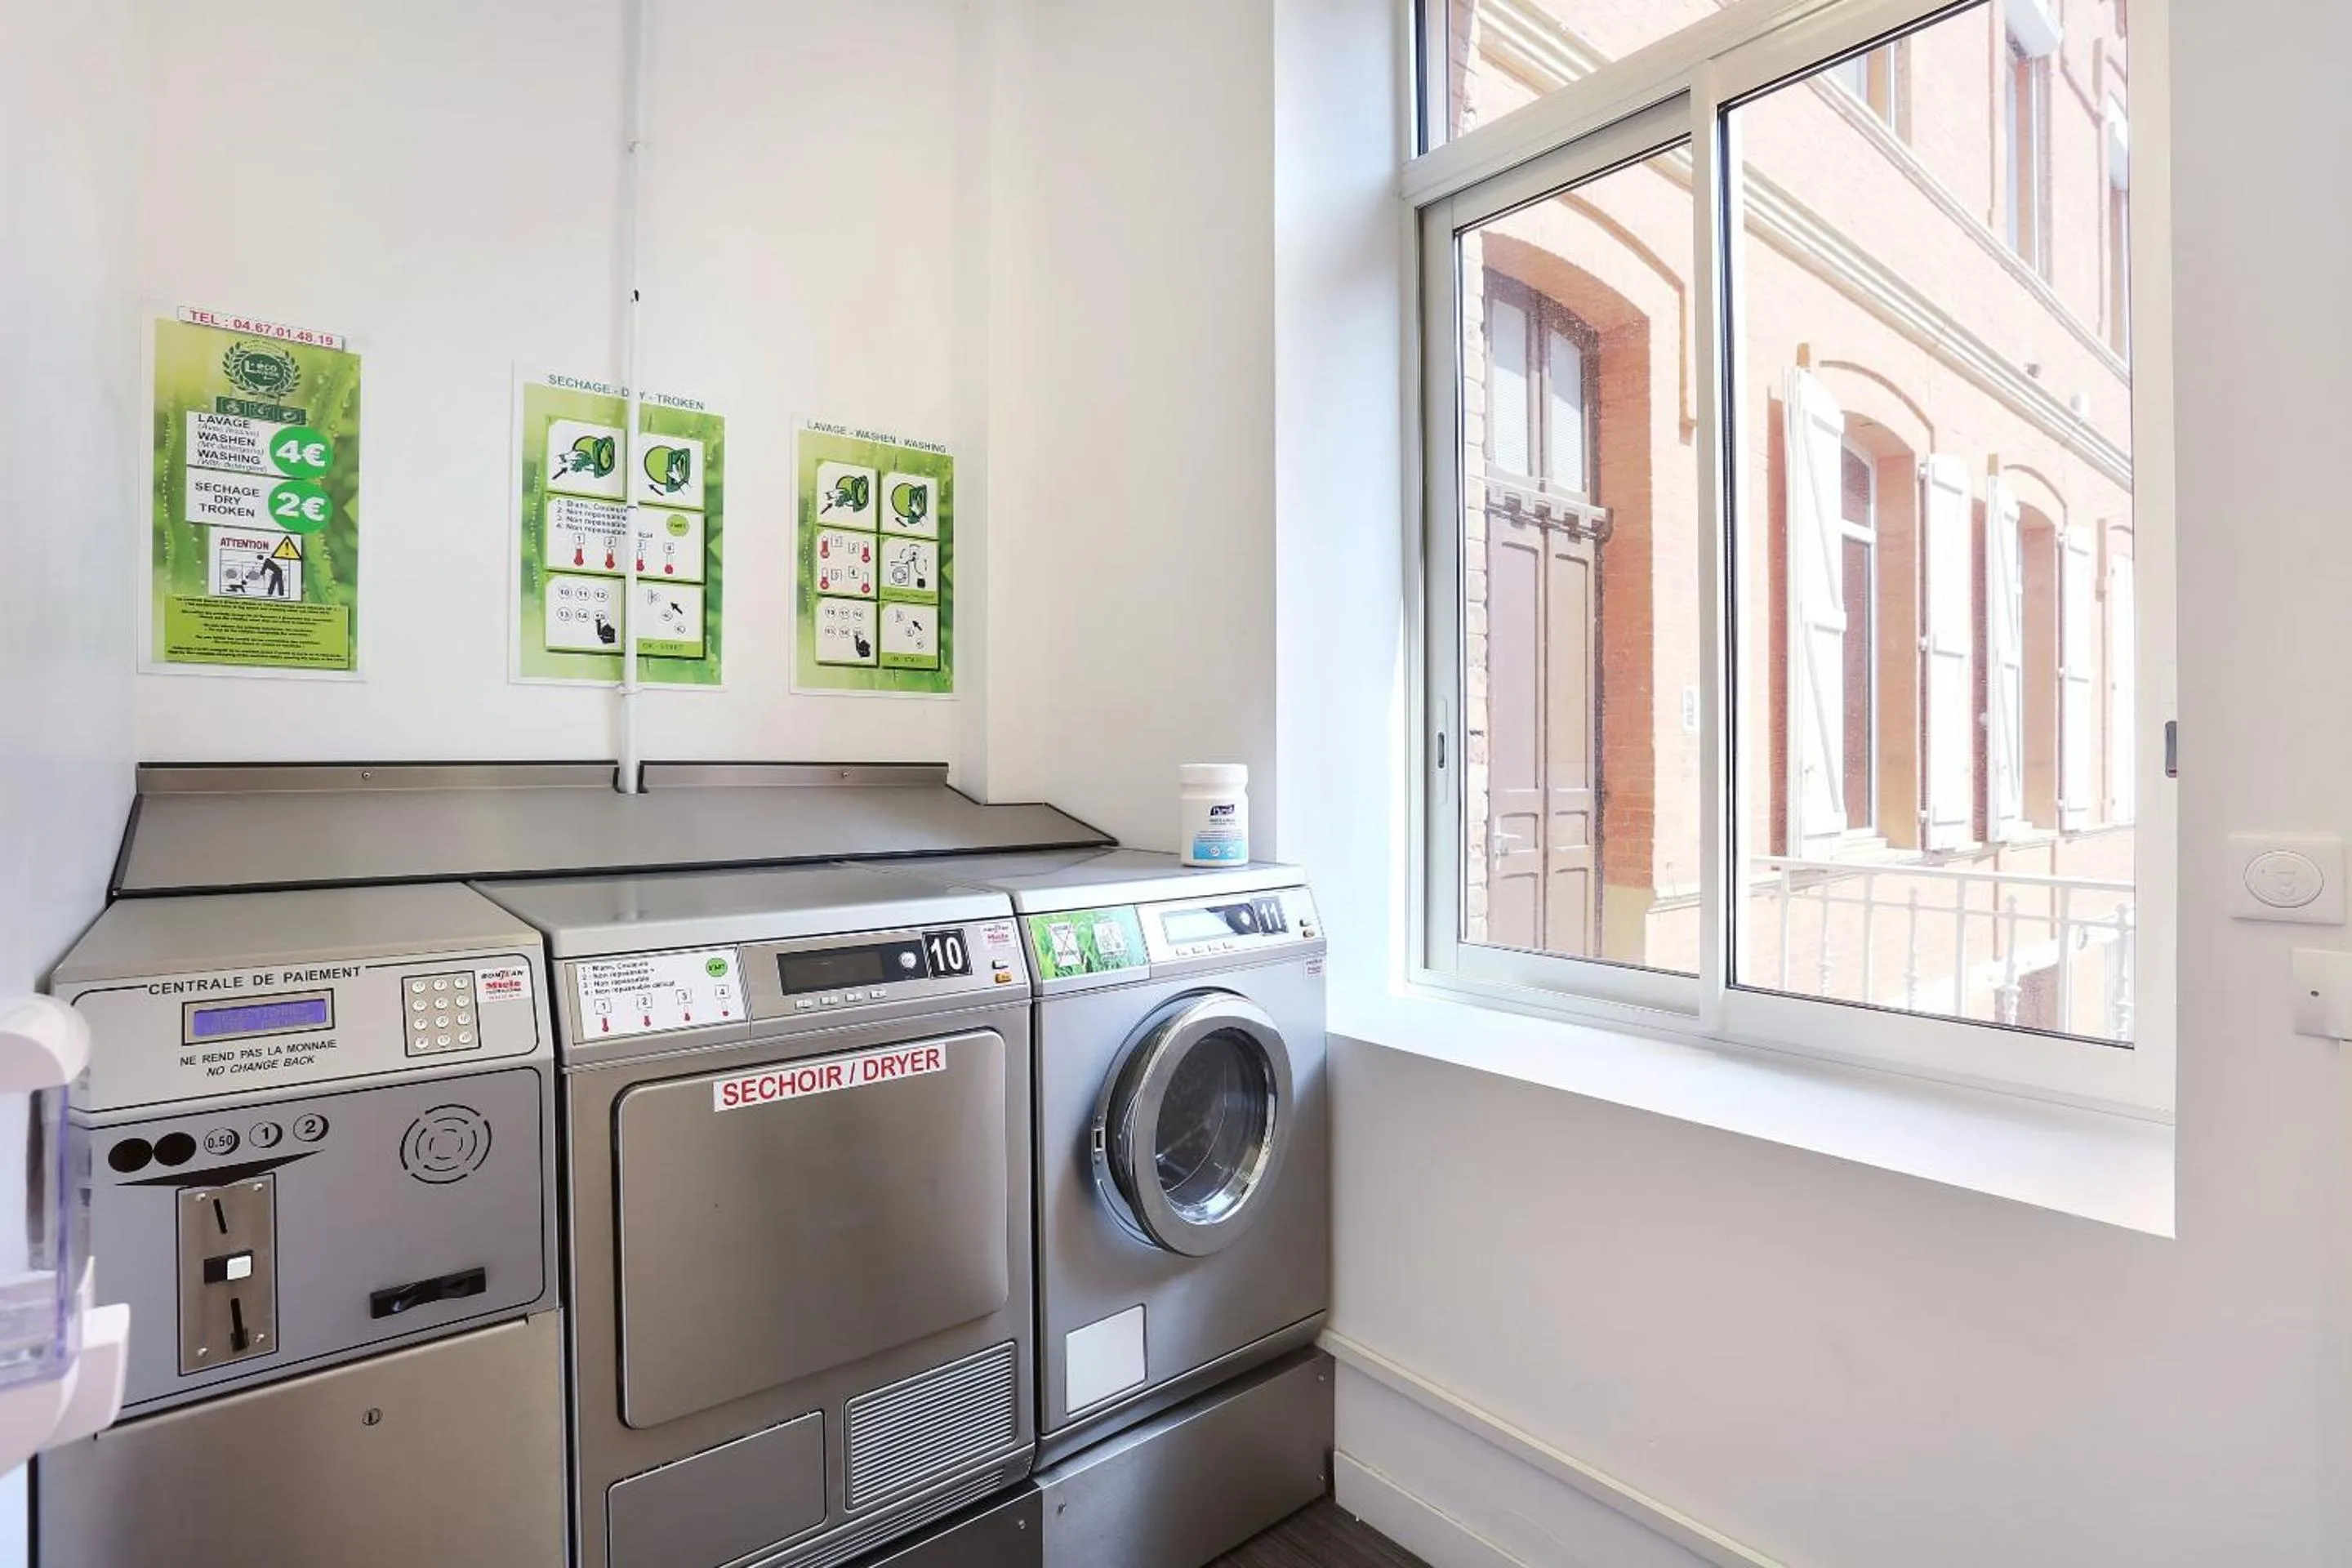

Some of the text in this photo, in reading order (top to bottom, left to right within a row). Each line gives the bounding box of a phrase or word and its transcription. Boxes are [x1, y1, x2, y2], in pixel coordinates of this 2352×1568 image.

[189, 310, 219, 325] TEL
[233, 318, 333, 345] 04.67.01.48.19
[547, 374, 612, 394] SECHAGE
[621, 387, 645, 400] DY
[655, 394, 704, 411] TROKEN
[198, 414, 250, 429] LAVAGE
[197, 431, 255, 447] WASHEN
[807, 419, 846, 435] LAVAGE
[855, 430, 896, 444] WASHEN
[903, 439, 947, 453] WASHING
[197, 449, 261, 465] WASHING
[276, 440, 325, 467] 4€
[195, 482, 260, 497] SECHAGE
[213, 494, 242, 506] DRY
[198, 503, 255, 518] TROKEN
[275, 492, 325, 521] 2€
[220, 537, 270, 550] ATTENTION
[1261, 902, 1281, 929] 11
[930, 937, 963, 972] 10
[149, 966, 361, 995] CENTRALE DE PAIEMENT
[180, 1039, 336, 1067] NE REND PAS LA MONNAIE
[206, 1055, 315, 1076] NO CHANGE BACK
[723, 1065, 843, 1107] SECHOIR
[863, 1048, 941, 1081] DRYER
[206, 1120, 317, 1150] 0.50 1 2
